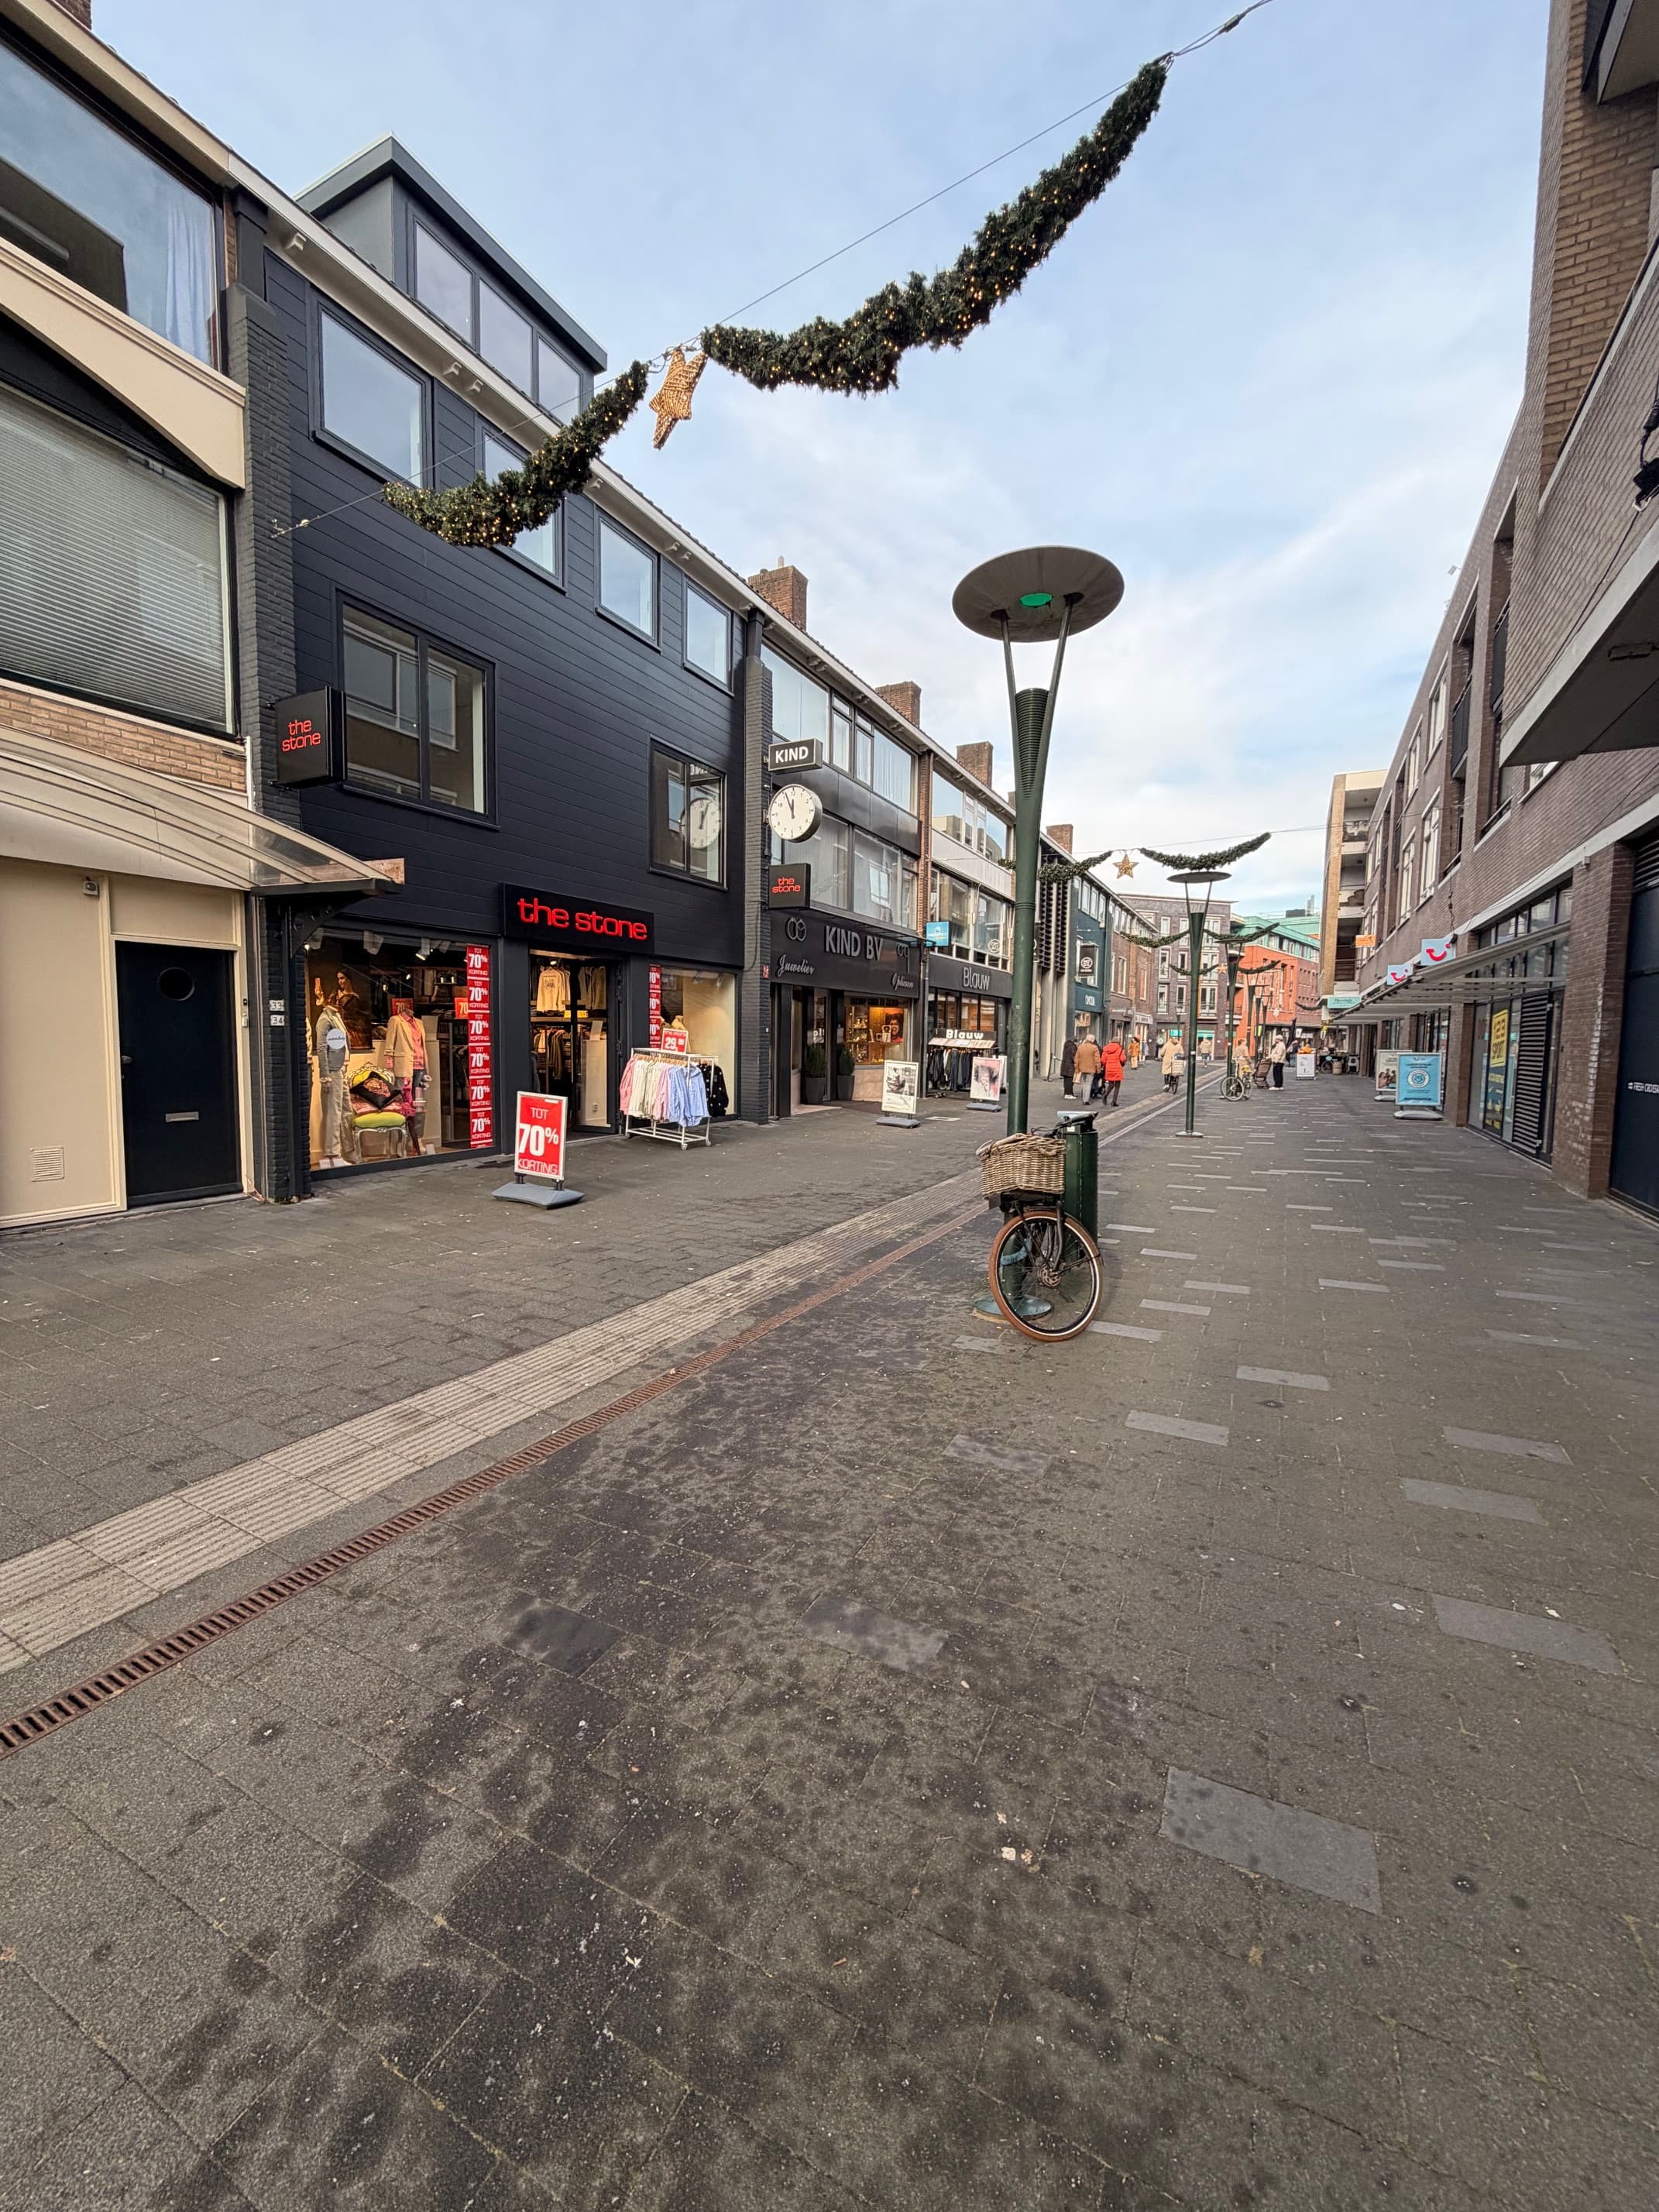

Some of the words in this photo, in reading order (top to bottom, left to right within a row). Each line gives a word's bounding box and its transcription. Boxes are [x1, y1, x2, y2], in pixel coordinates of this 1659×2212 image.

[287, 719, 311, 736] the
[282, 732, 321, 751] stone
[775, 746, 809, 764] KIND
[771, 884, 801, 893] stone
[778, 877, 795, 886] the
[517, 898, 569, 929] the
[575, 911, 647, 940] stone
[826, 926, 861, 957] KIND
[866, 935, 883, 961] BV
[469, 953, 488, 969] 70%
[777, 954, 815, 977] Juwelier
[963, 967, 990, 991] Blauw
[469, 987, 488, 1001] 70%
[469, 1020, 489, 1035] 70%
[946, 1029, 984, 1039] Blauw
[470, 1053, 489, 1067] 70%
[471, 1086, 490, 1100] 70%
[531, 1107, 549, 1120] TOT
[472, 1118, 491, 1132] 70%
[519, 1123, 558, 1157] 70%
[518, 1159, 558, 1175] KORTING
